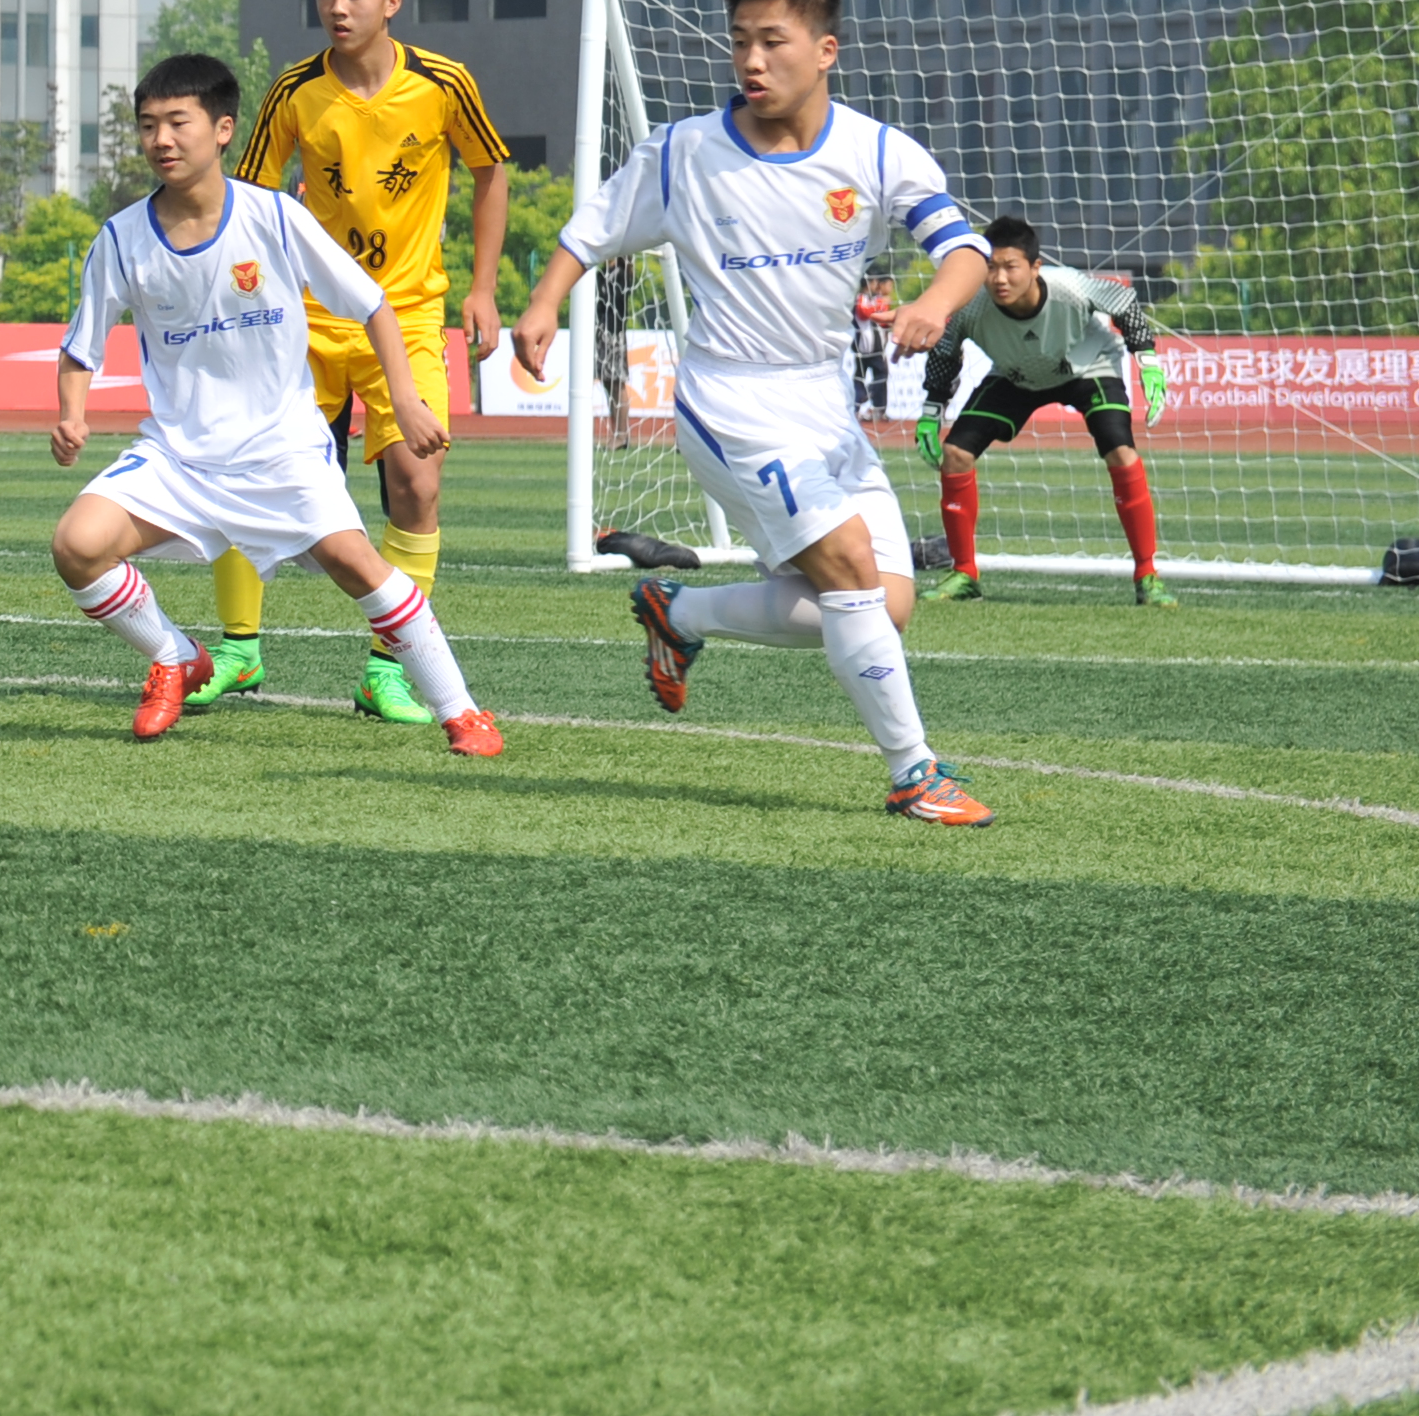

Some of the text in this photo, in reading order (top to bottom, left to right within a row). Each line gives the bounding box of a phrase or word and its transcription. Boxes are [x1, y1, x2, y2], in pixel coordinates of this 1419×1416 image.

[720, 248, 826, 271] Isonic
[239, 307, 285, 329] 至强
[1190, 386, 1270, 408] Football
[1275, 387, 1409, 413] Development
[103, 453, 149, 479] 7
[756, 457, 799, 518] 7
